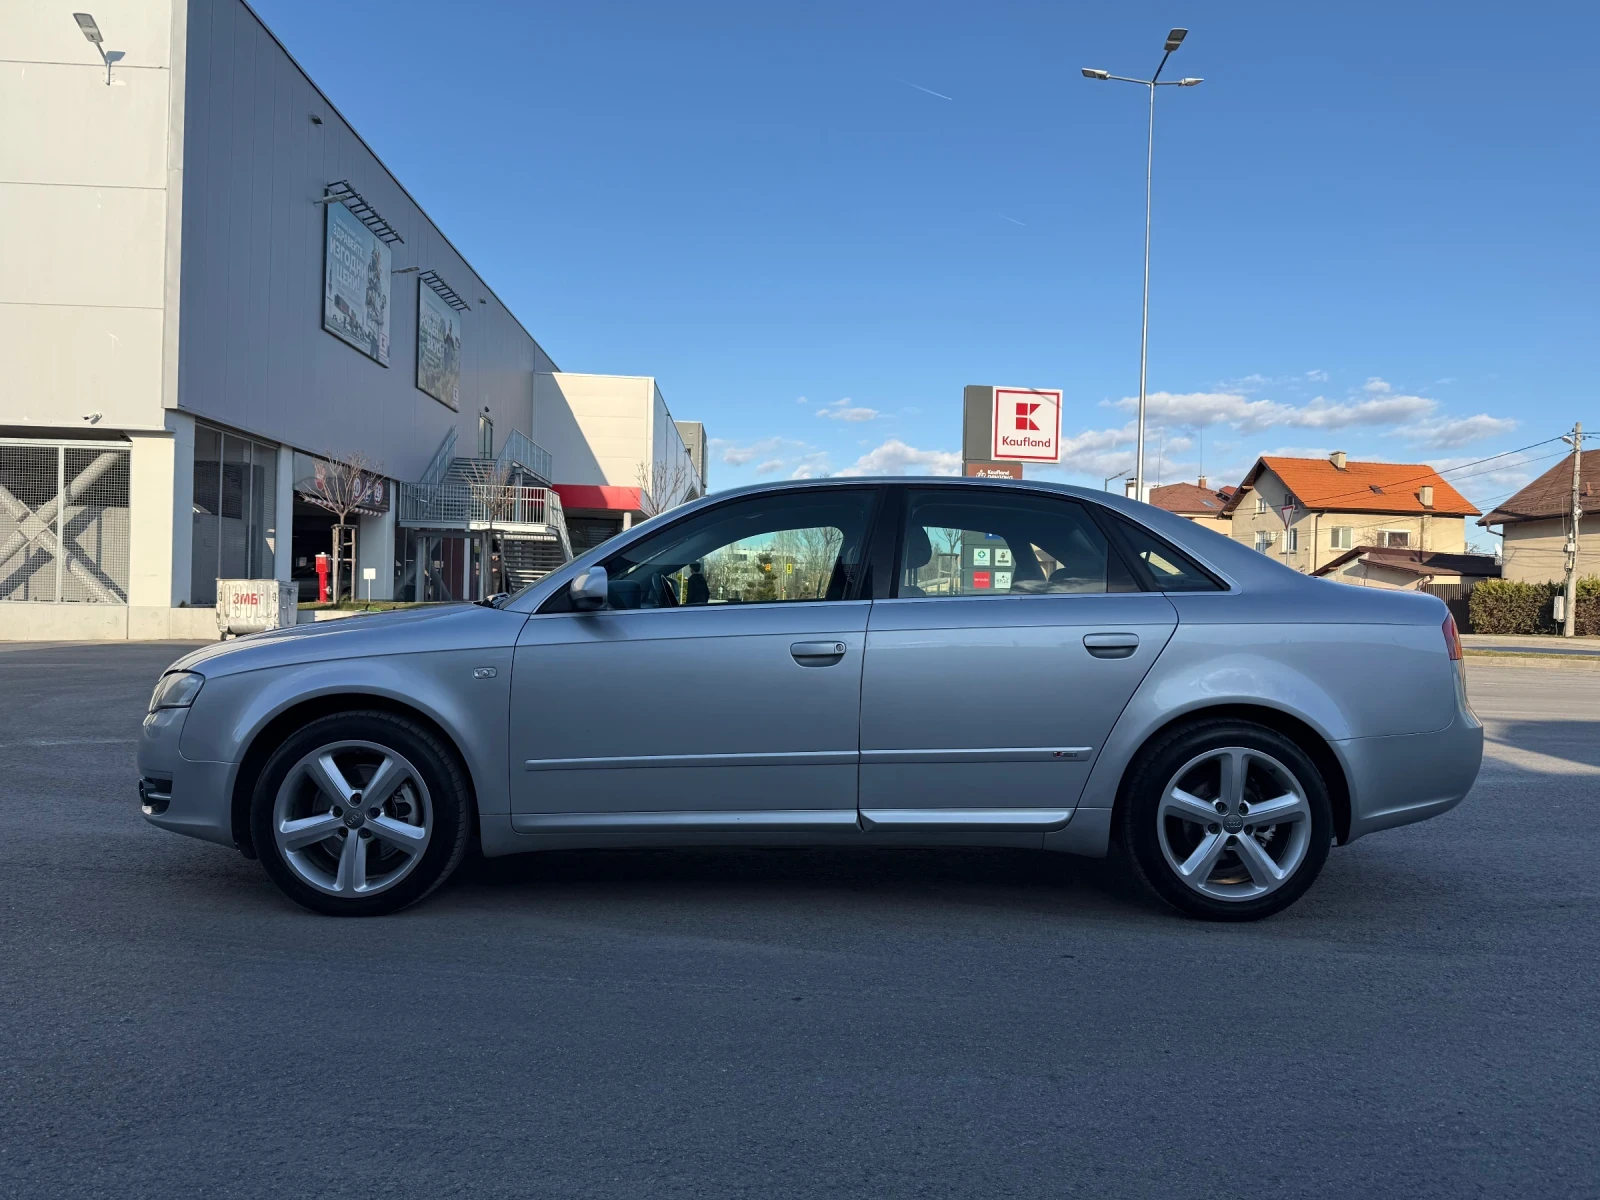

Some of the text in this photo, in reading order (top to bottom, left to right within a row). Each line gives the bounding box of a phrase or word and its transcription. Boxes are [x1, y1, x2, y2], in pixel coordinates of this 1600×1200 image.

[330, 237, 367, 280] ИЗГОДНИ
[336, 263, 360, 293] ЦЕНИ!
[1002, 436, 1051, 447] Kaufland
